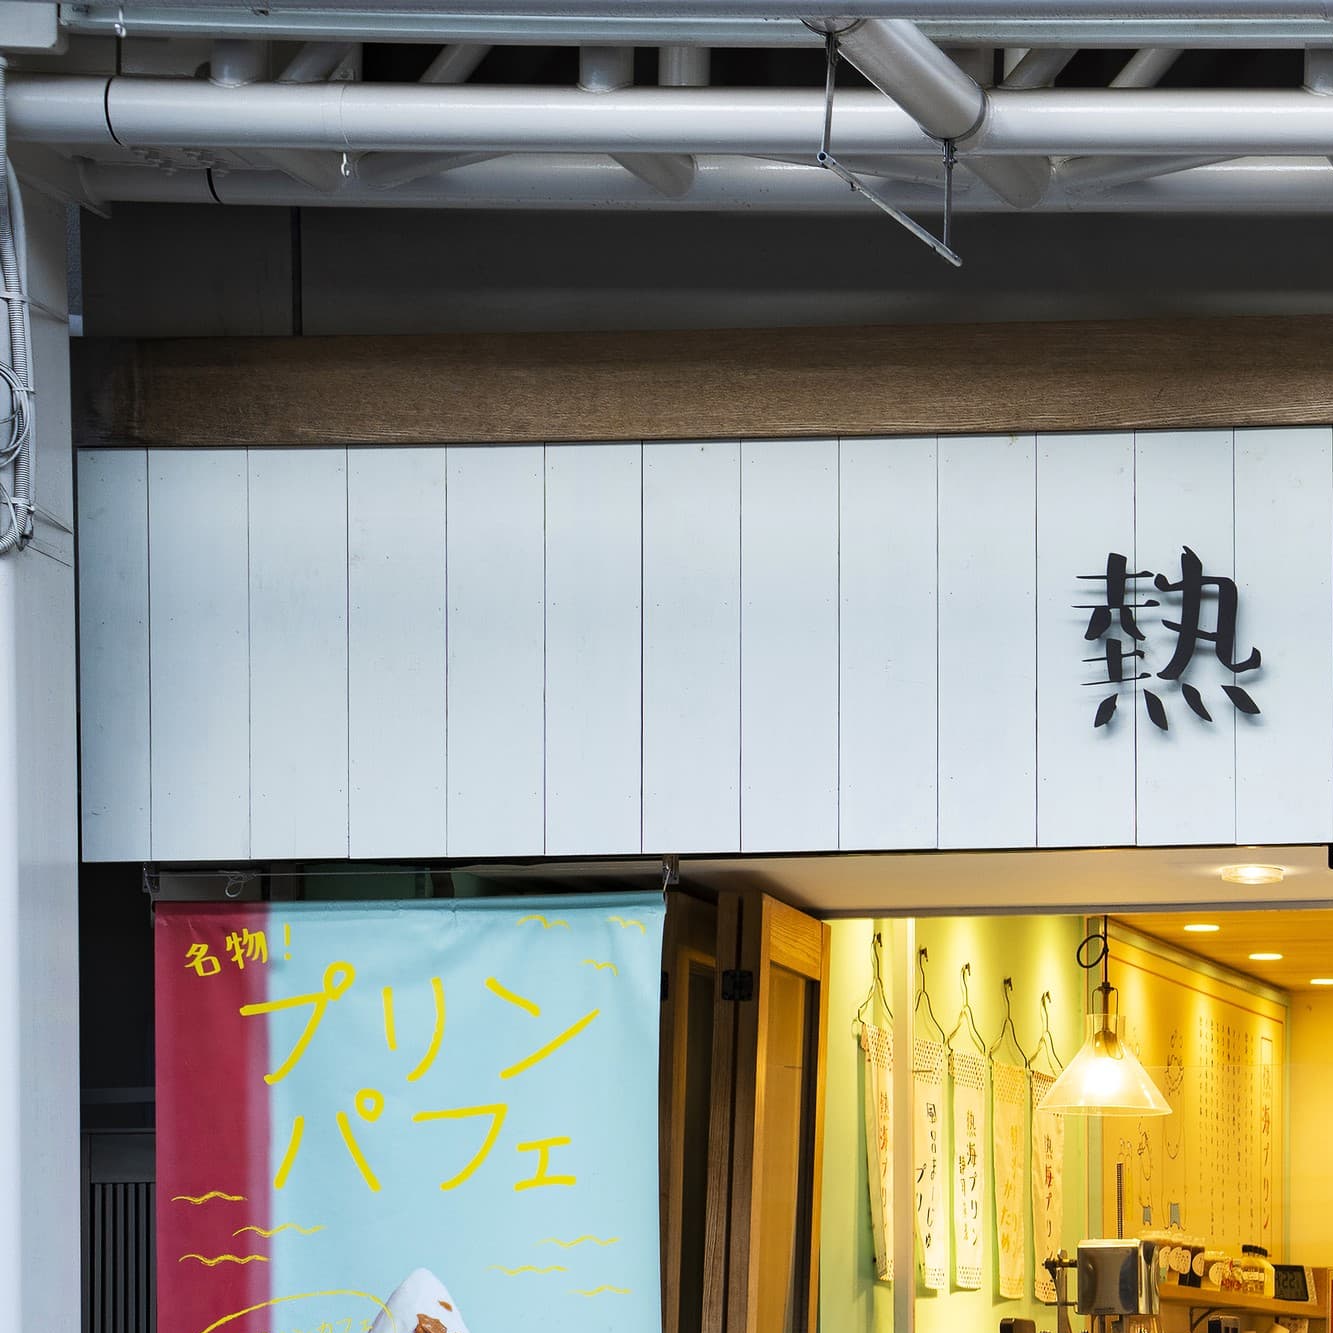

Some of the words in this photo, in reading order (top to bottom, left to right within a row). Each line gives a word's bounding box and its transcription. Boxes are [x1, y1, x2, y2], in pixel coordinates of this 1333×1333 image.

[184, 924, 292, 977] 名物!
[240, 962, 600, 1085] プリン
[273, 1089, 577, 1192] パフェ
